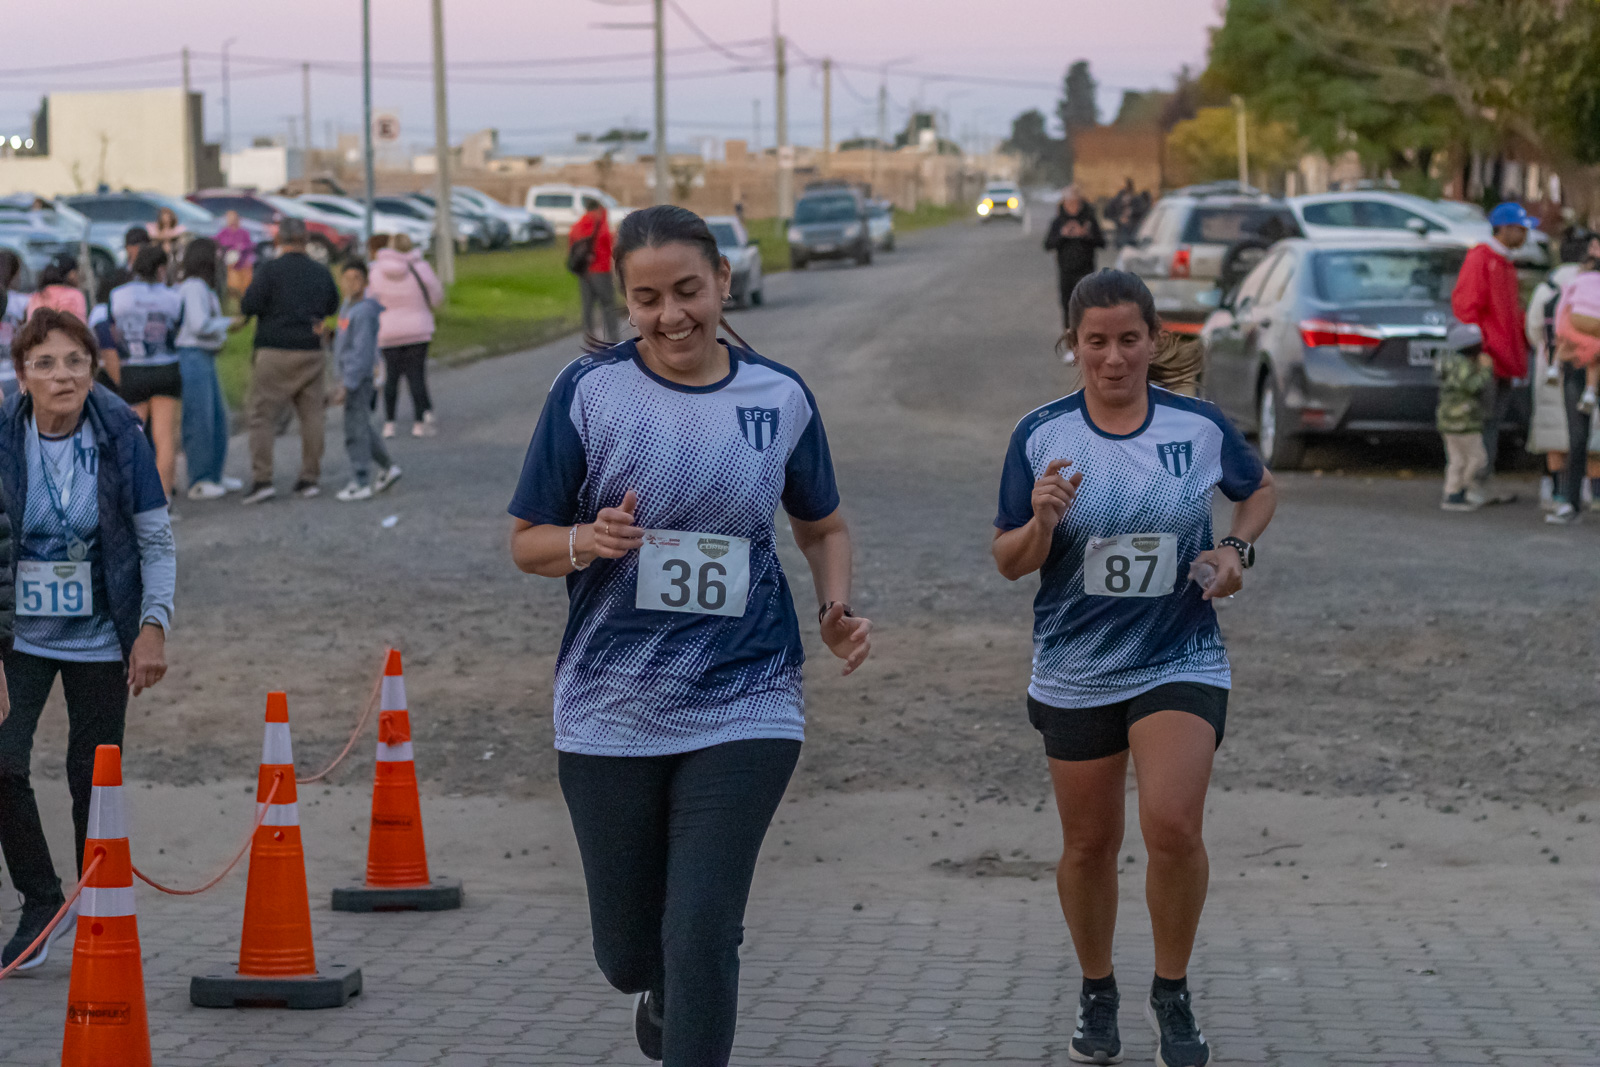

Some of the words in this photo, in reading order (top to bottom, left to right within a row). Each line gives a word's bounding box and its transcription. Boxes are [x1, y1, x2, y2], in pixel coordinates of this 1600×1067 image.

[744, 410, 772, 421] SFC
[1163, 444, 1187, 454] SFC
[660, 558, 727, 610] 36
[1105, 555, 1158, 593] 87
[22, 580, 83, 612] 519
